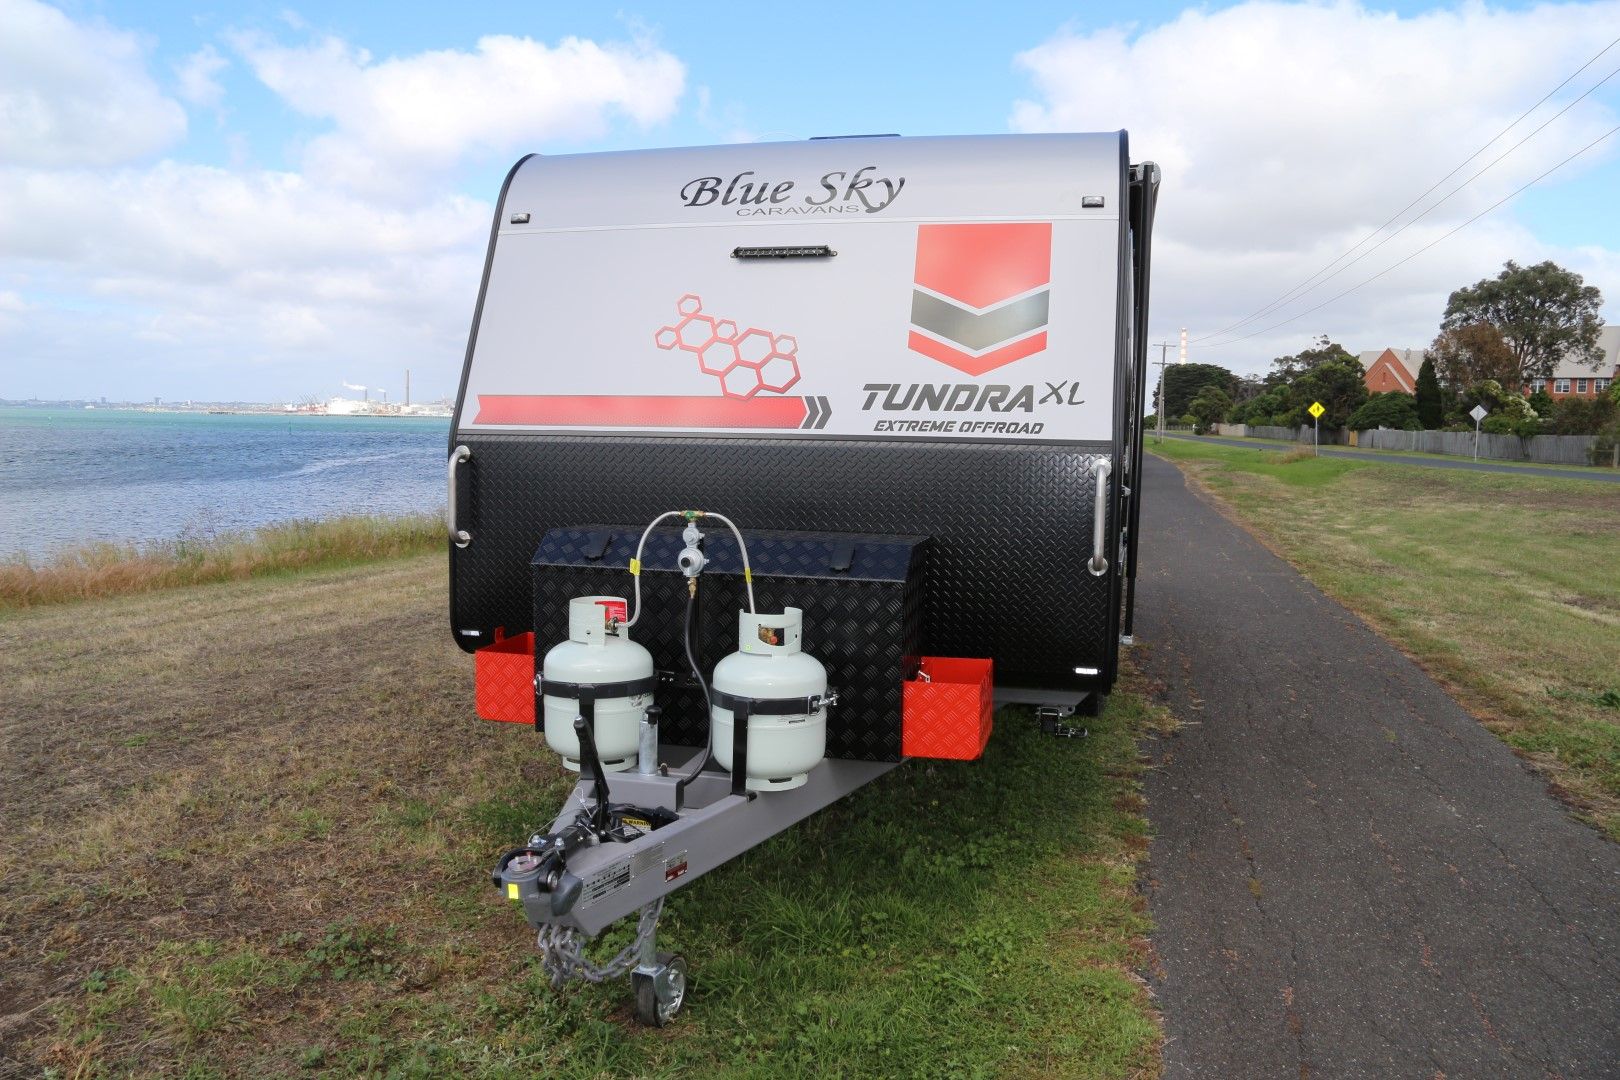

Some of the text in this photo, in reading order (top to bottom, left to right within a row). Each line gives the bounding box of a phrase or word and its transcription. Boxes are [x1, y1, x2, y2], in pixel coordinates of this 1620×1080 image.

[680, 166, 906, 213] Blue Sky
[736, 204, 859, 216] CARAVANS
[862, 380, 1085, 412] TUNDRA XL
[873, 419, 1045, 434] EXTREME OFFROAD
